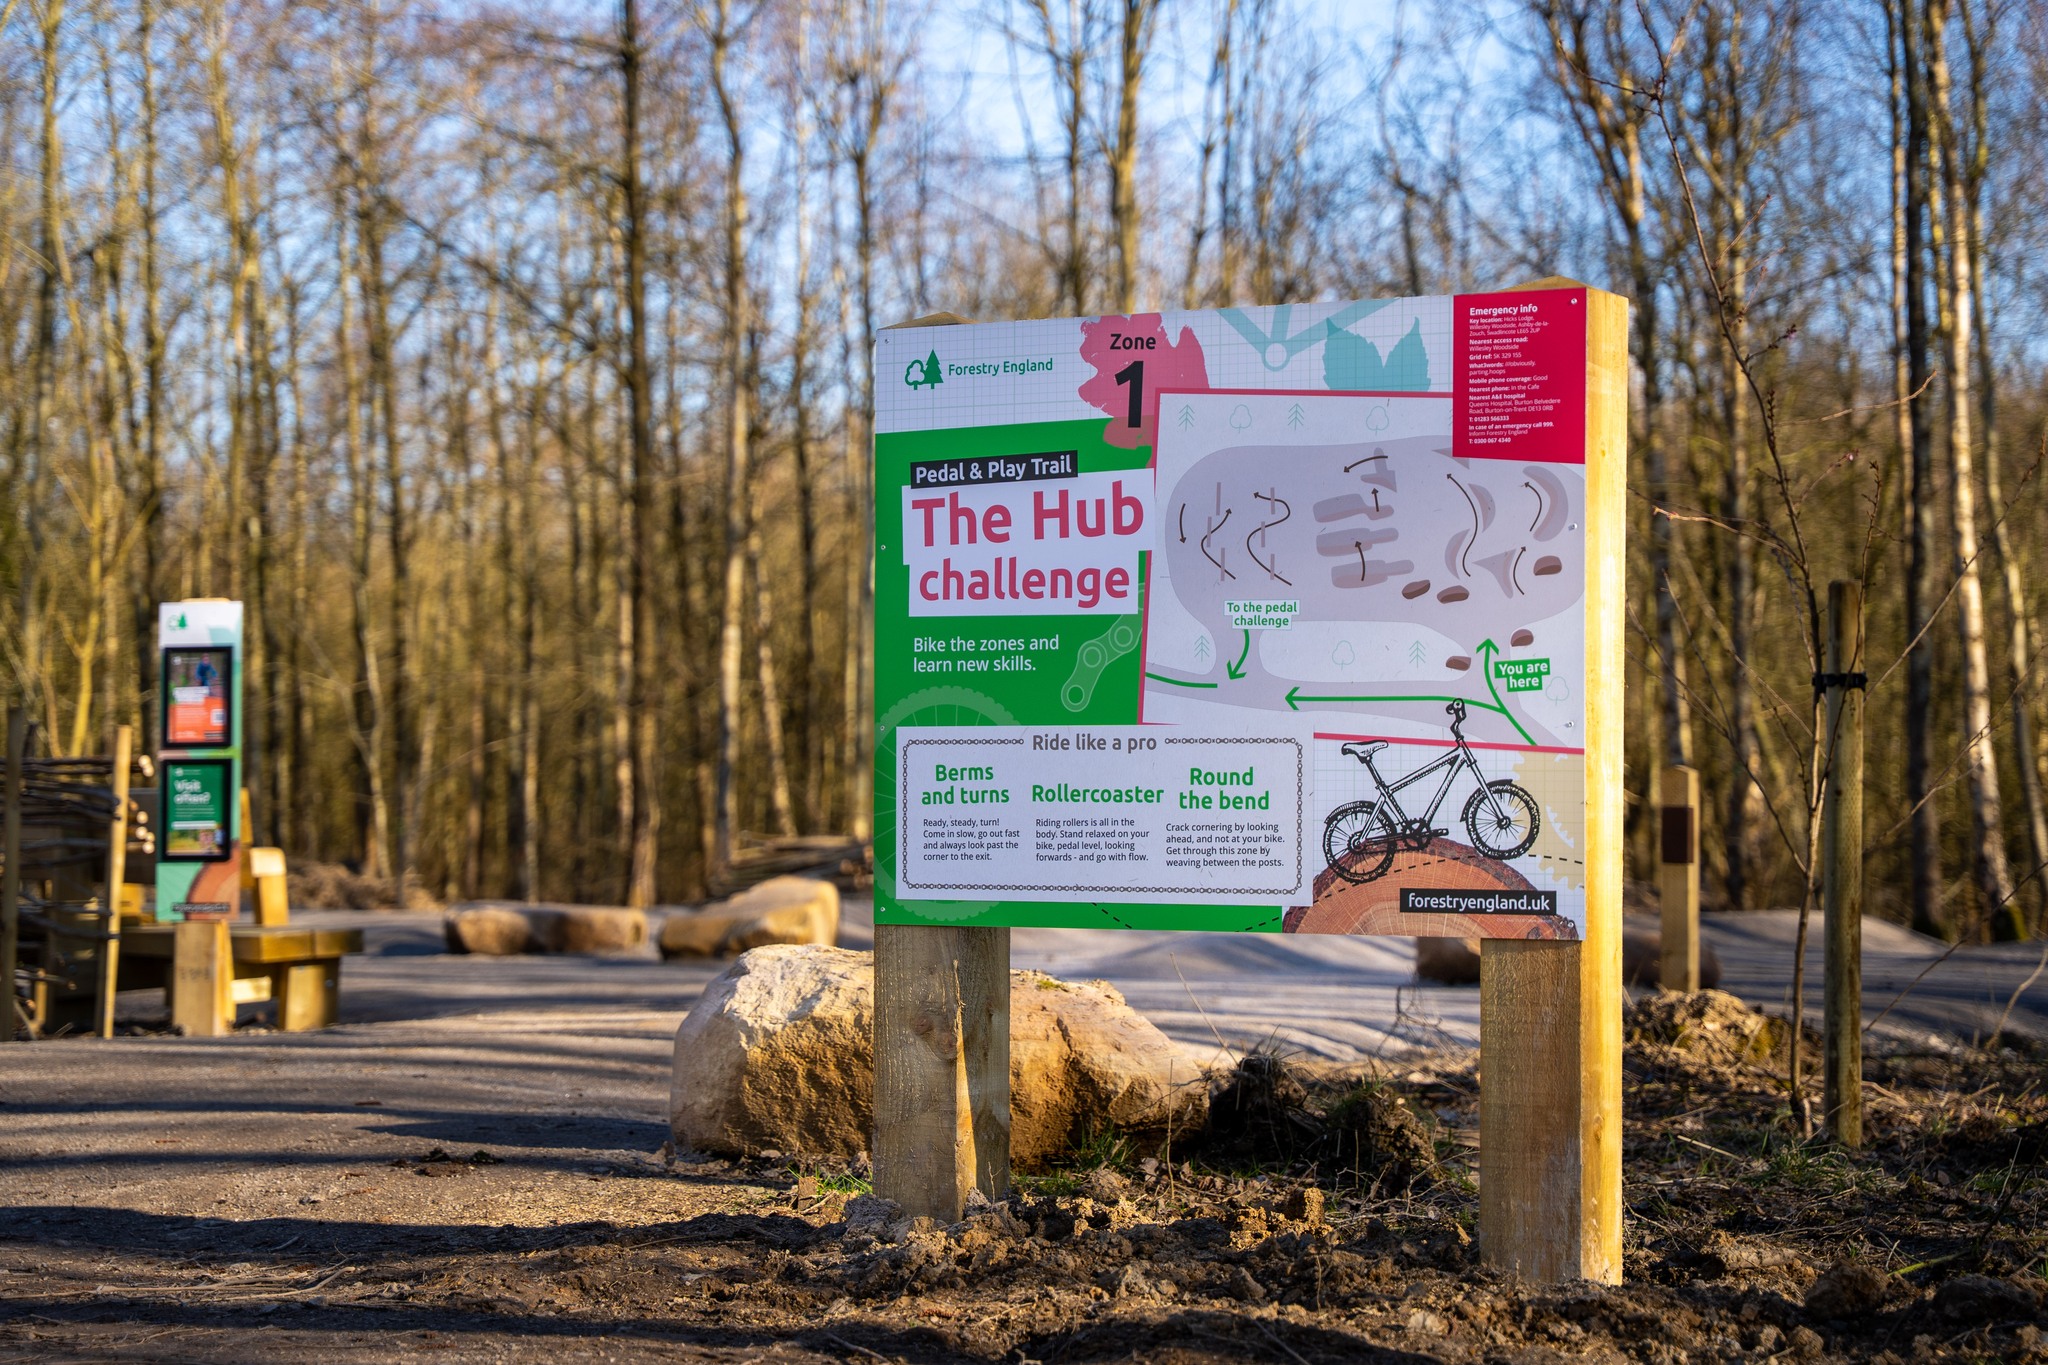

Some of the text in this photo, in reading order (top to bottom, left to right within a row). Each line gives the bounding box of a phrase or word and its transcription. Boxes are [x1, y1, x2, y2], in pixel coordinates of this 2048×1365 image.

[1470, 304, 1538, 316] Emergency info
[1110, 334, 1156, 350] Zone
[949, 358, 1053, 376] Forestry England
[1114, 360, 1144, 428] 1
[915, 455, 1072, 483] Pedal & Play Trail
[911, 480, 1144, 547] The Hub
[919, 556, 1130, 609] challenge
[1227, 602, 1297, 614] To the pedal
[1234, 615, 1289, 628] challenge
[914, 634, 1059, 652] Bike the zones and
[914, 655, 1036, 672] learn new skills.
[1499, 663, 1548, 675] You are
[1510, 676, 1539, 688] here
[1033, 734, 1157, 754] Ride like a pro
[935, 764, 994, 781] Berms
[1190, 766, 1253, 785] Round
[922, 786, 1010, 805] and turns
[1032, 783, 1164, 803] Rollercoaster
[1180, 790, 1269, 809] the bend
[923, 818, 1000, 828] Ready, steady, turn!
[1036, 819, 1060, 828] Riding
[1099, 818, 1109, 826] all
[1111, 818, 1118, 826] in
[1121, 818, 1134, 826] the
[1166, 823, 1279, 833] Crack cornering by looking
[923, 830, 945, 838] Come
[957, 830, 976, 838] slow,
[1005, 829, 1020, 837] fast
[1036, 830, 1058, 840] body.
[1060, 830, 1083, 838] Stand
[1085, 830, 1115, 838] relaxed
[1131, 831, 1149, 839] your
[1166, 835, 1194, 844] ahead,
[1197, 835, 1212, 843] and
[1242, 836, 1262, 845] your
[923, 841, 1018, 851] and always look past the
[1036, 841, 1135, 851] bike, pedal level, looking
[1166, 847, 1180, 855] Get
[1183, 847, 1216, 856] through
[1219, 847, 1235, 855] this
[1260, 846, 1270, 856] by
[1036, 853, 1072, 861] forwards
[1079, 853, 1094, 861] and
[1096, 855, 1106, 863] go
[1108, 853, 1127, 861] with
[1129, 853, 1148, 861] flow.
[1166, 858, 1284, 868] weaving between the posts.
[1408, 893, 1550, 912] forestryengland.uk
